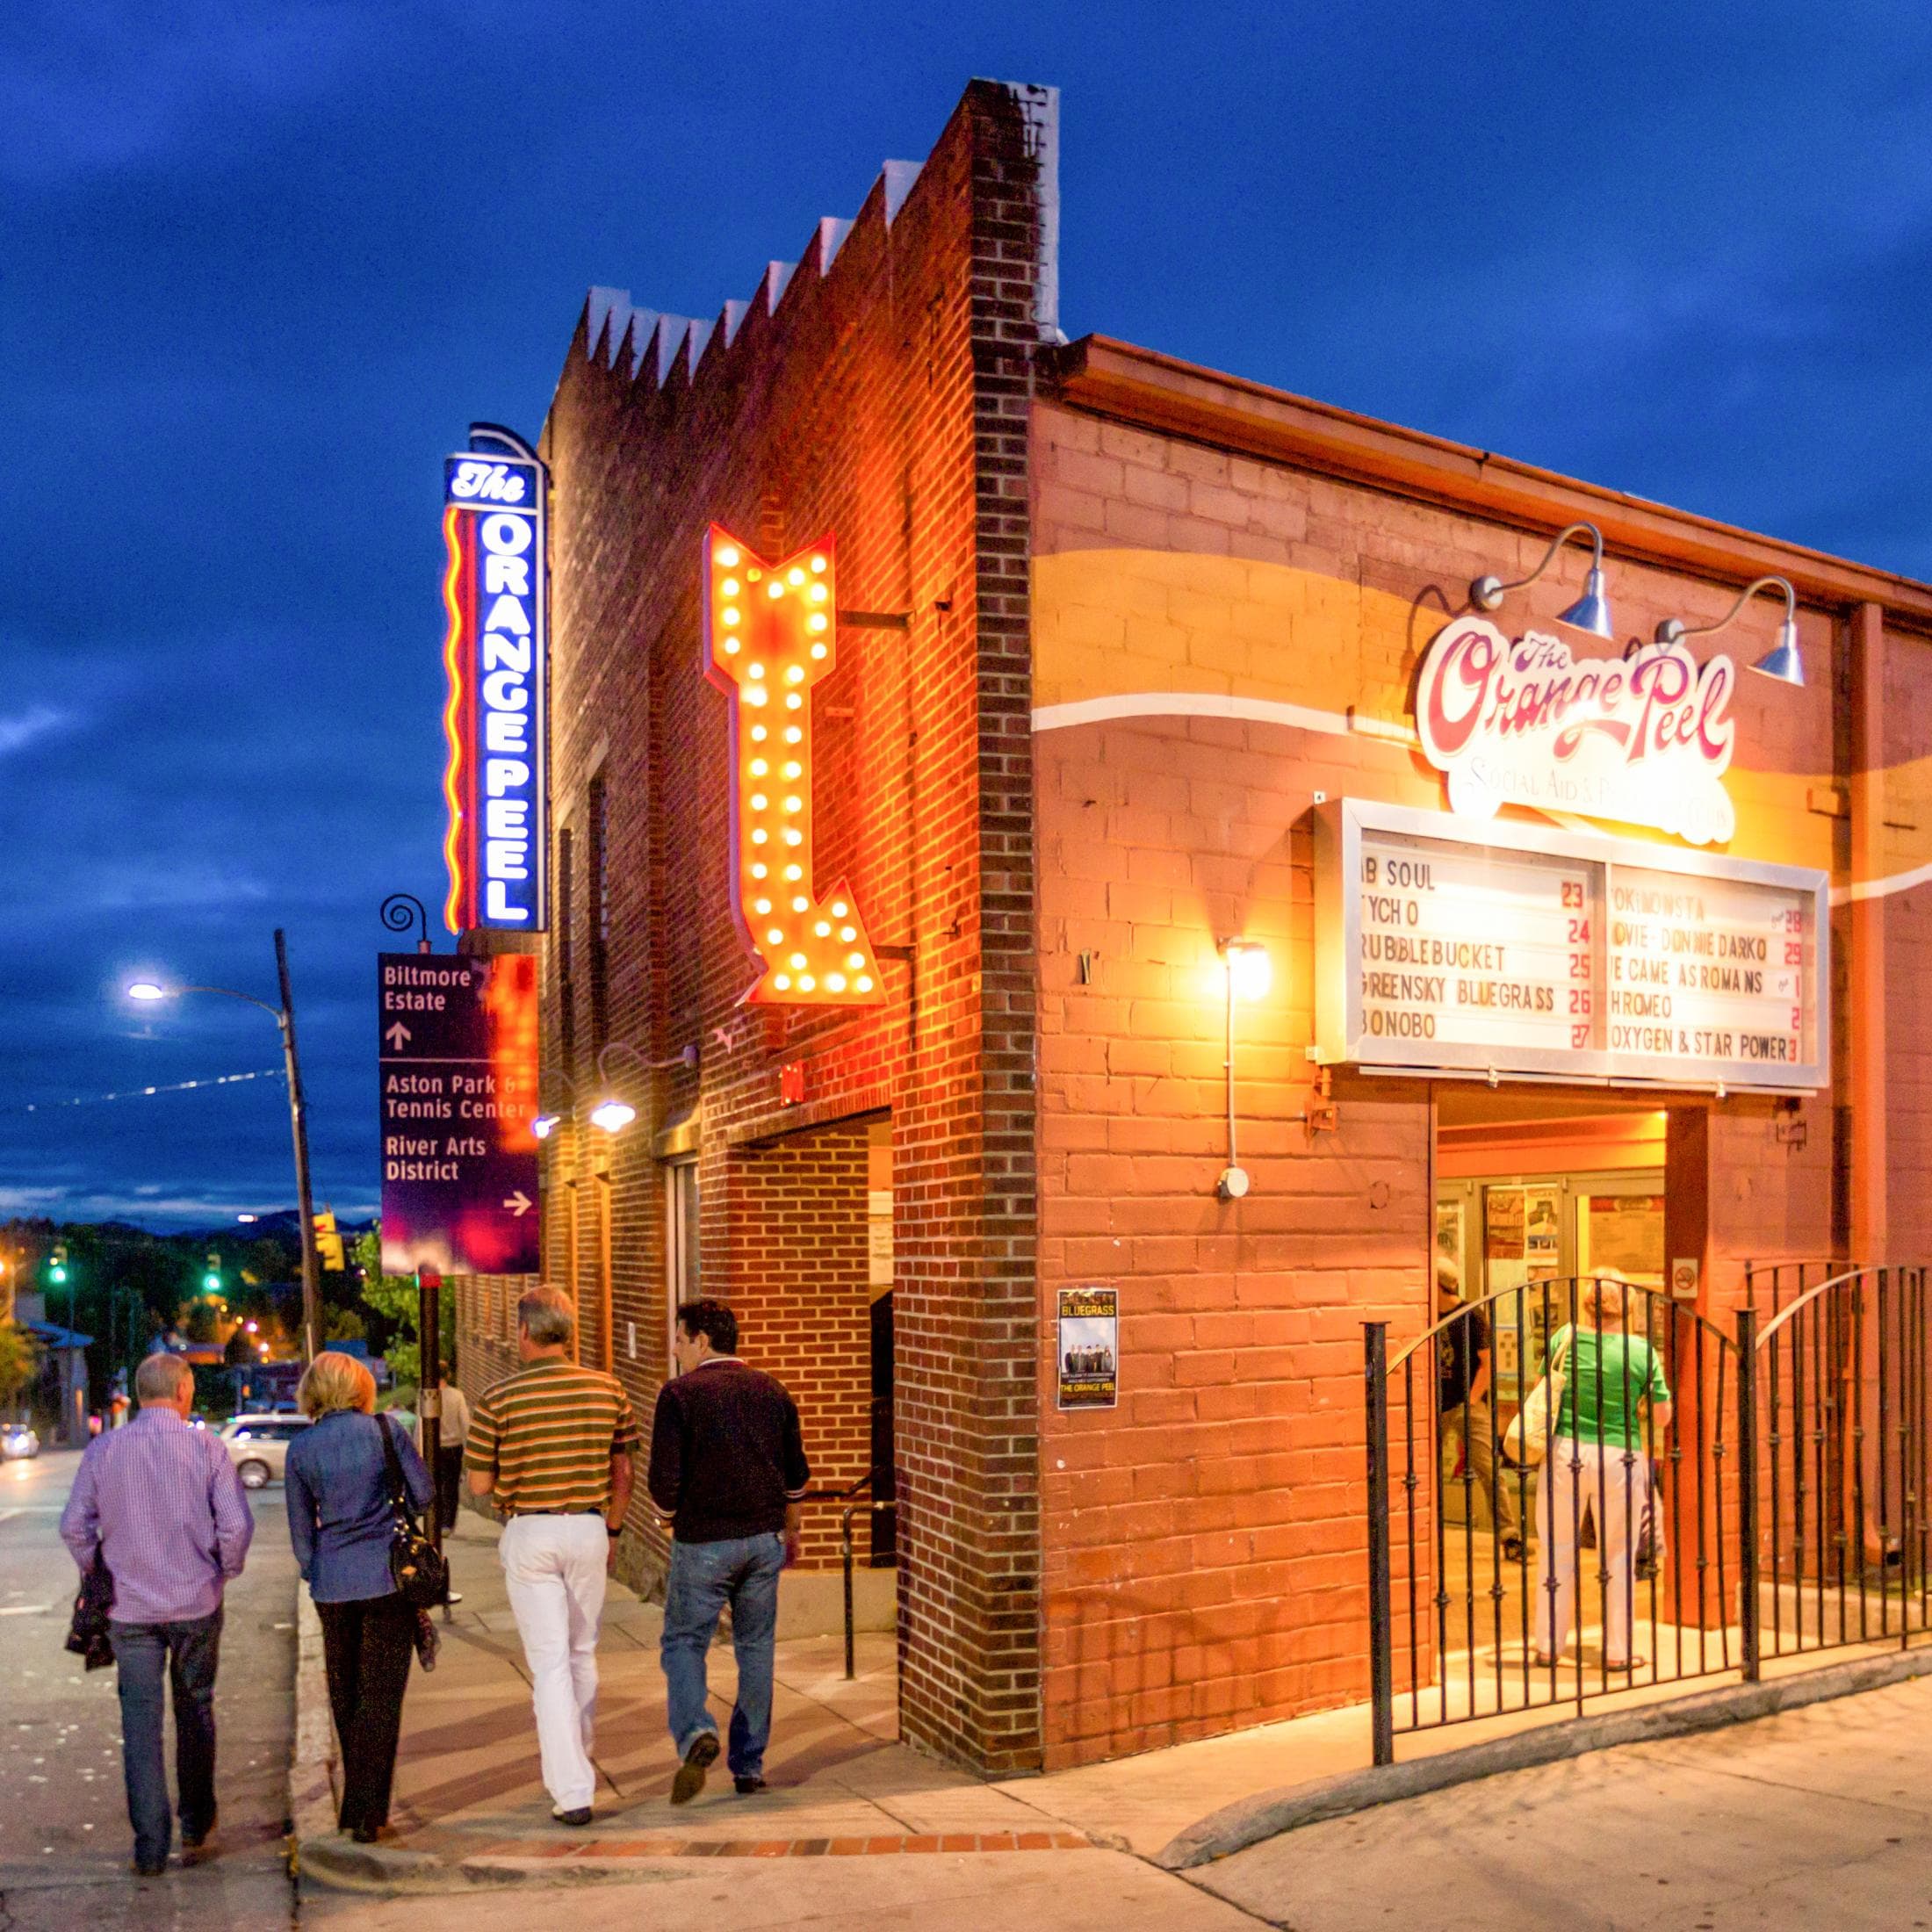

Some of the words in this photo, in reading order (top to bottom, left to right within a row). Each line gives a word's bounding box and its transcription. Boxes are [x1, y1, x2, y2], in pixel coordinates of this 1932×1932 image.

[451, 461, 525, 503] The
[481, 513, 532, 752] ORANGE
[1514, 638, 1568, 673] The
[1428, 631, 1631, 759] Orange
[1627, 654, 1728, 762] Peel
[487, 758, 530, 920] PEEL
[1361, 857, 1378, 883] B
[1387, 860, 1435, 890] SOUL
[1561, 881, 1583, 908] 23
[1361, 895, 1418, 926] YCHO
[1568, 919, 1590, 944] 24
[1662, 928, 1713, 957] DONNIE
[1719, 934, 1767, 962] DARKO
[1784, 942, 1801, 966] 29
[384, 966, 472, 987] Biltmore
[1569, 954, 1590, 978] 25
[1611, 956, 1621, 981] E
[1629, 958, 1669, 984] CAME
[1679, 963, 1697, 988] AS
[1700, 967, 1763, 994] ROMANS
[385, 991, 446, 1011] Estate
[1458, 979, 1554, 1011] BLUEGRASS
[1569, 990, 1590, 1014] 26
[1791, 1007, 1800, 1030] 2
[1571, 1025, 1590, 1049] 27
[1611, 1025, 1673, 1053] OXYGEN
[1679, 1030, 1689, 1052] &
[1694, 1032, 1733, 1057] STAR
[1740, 1034, 1786, 1062] POWER
[1789, 1040, 1798, 1063] 3
[386, 1074, 443, 1093] Aston
[452, 1075, 496, 1094] Park
[386, 1099, 452, 1119] Tennis
[460, 1099, 526, 1119] Center
[386, 1135, 438, 1156] River
[446, 1137, 487, 1157] Arts
[386, 1160, 458, 1181] District
[1062, 1305, 1114, 1316] BLUEGRASS
[1074, 1383, 1100, 1393] ORANGE
[1101, 1382, 1115, 1391] PEEL
